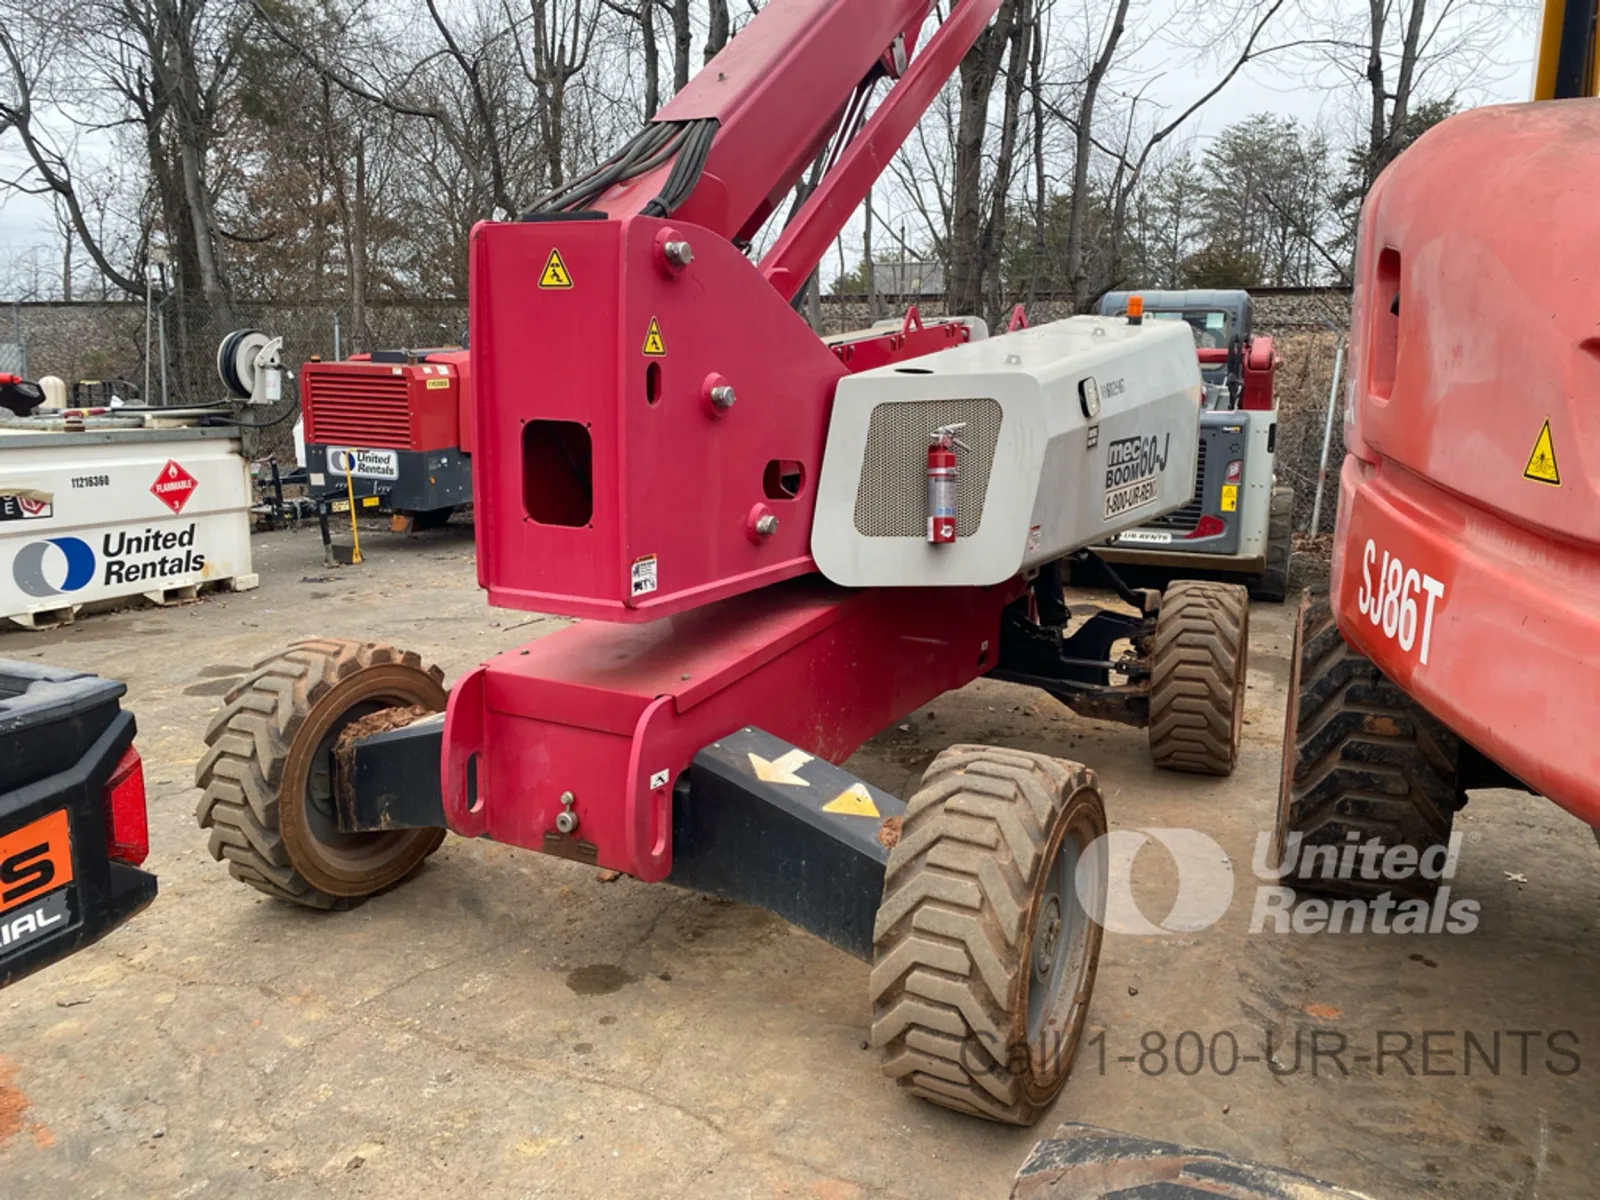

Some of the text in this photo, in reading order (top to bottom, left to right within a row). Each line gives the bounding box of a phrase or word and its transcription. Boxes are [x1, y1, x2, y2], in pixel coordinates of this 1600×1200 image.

[356, 453, 391, 466] United
[1108, 436, 1141, 467] mec
[357, 463, 395, 476] Rentals
[1106, 462, 1140, 489] BOOM
[156, 479, 193, 493] FLAMMABLE
[173, 501, 180, 509] 3
[102, 523, 196, 557] United
[104, 550, 205, 586] Rentals
[1358, 538, 1445, 665] SJ86T
[0, 908, 62, 948] IAL
